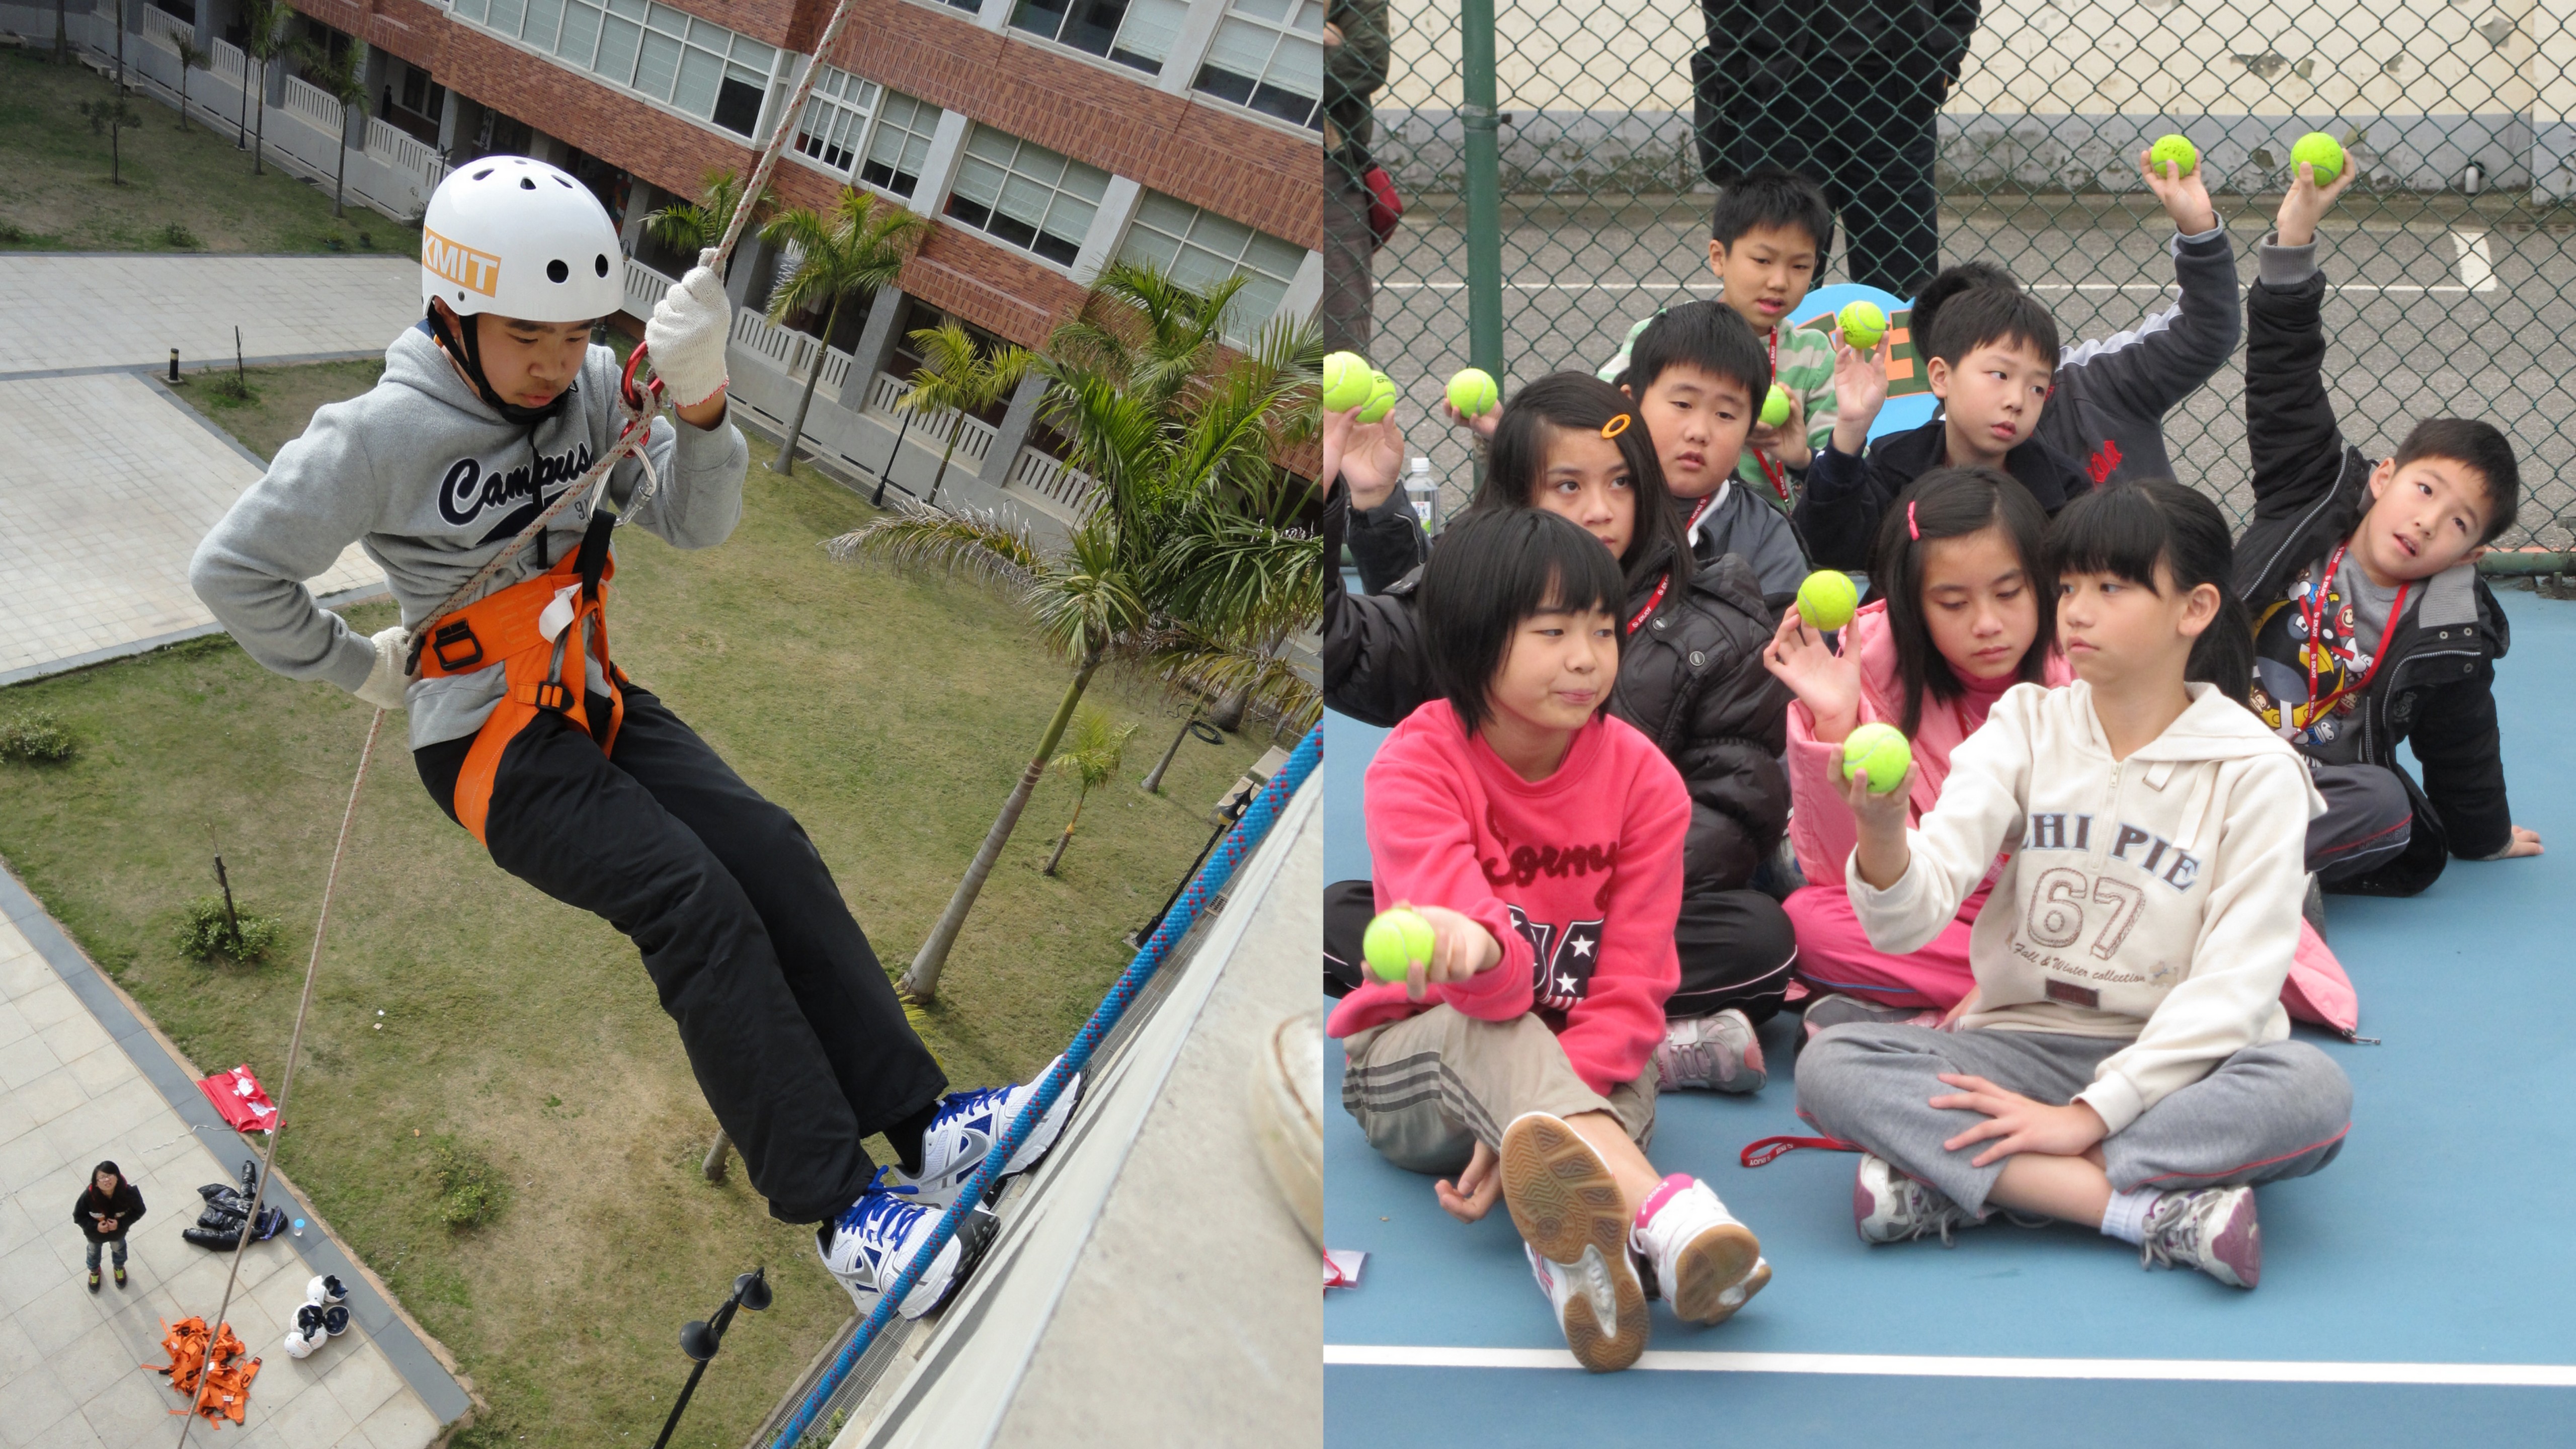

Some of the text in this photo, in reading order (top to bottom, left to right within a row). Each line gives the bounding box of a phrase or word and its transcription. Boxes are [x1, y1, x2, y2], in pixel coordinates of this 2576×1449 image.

[437, 441, 593, 526] Campus
[2319, 581, 2329, 597] ENJOY
[1638, 606, 1652, 623] ENJOY
[2109, 822, 2202, 894] PIE
[2027, 867, 2146, 960] 67
[2014, 943, 2146, 982] Fall & Winter collection
[1749, 1157, 1766, 1166] ENJOY
